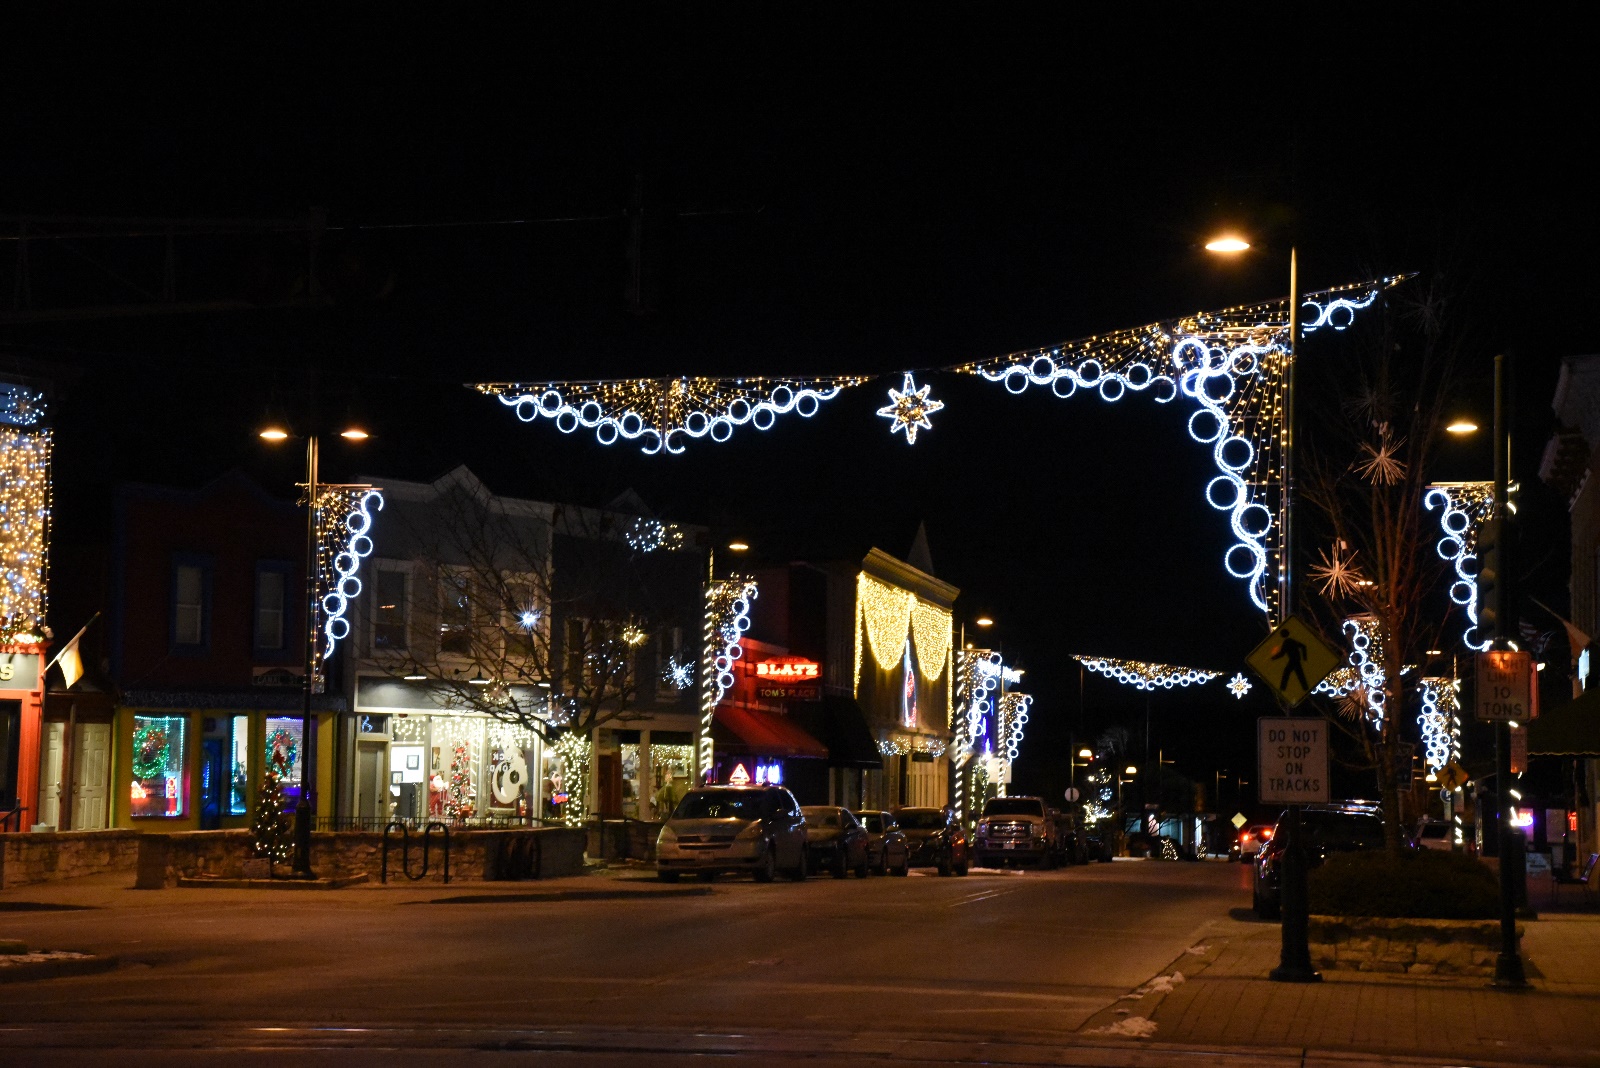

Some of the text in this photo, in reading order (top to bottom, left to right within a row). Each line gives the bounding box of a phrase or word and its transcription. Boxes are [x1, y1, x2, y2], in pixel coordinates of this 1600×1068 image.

[757, 663, 819, 676] BLATZ
[1487, 672, 1517, 682] LIMIT
[761, 688, 786, 698] TOM'S
[1494, 686, 1511, 699] 10
[1483, 702, 1523, 716] TONS
[1269, 729, 1318, 743] DO NOT
[1278, 746, 1311, 759] STOP
[1286, 762, 1303, 775] ON
[1269, 778, 1320, 792] TRACKS
